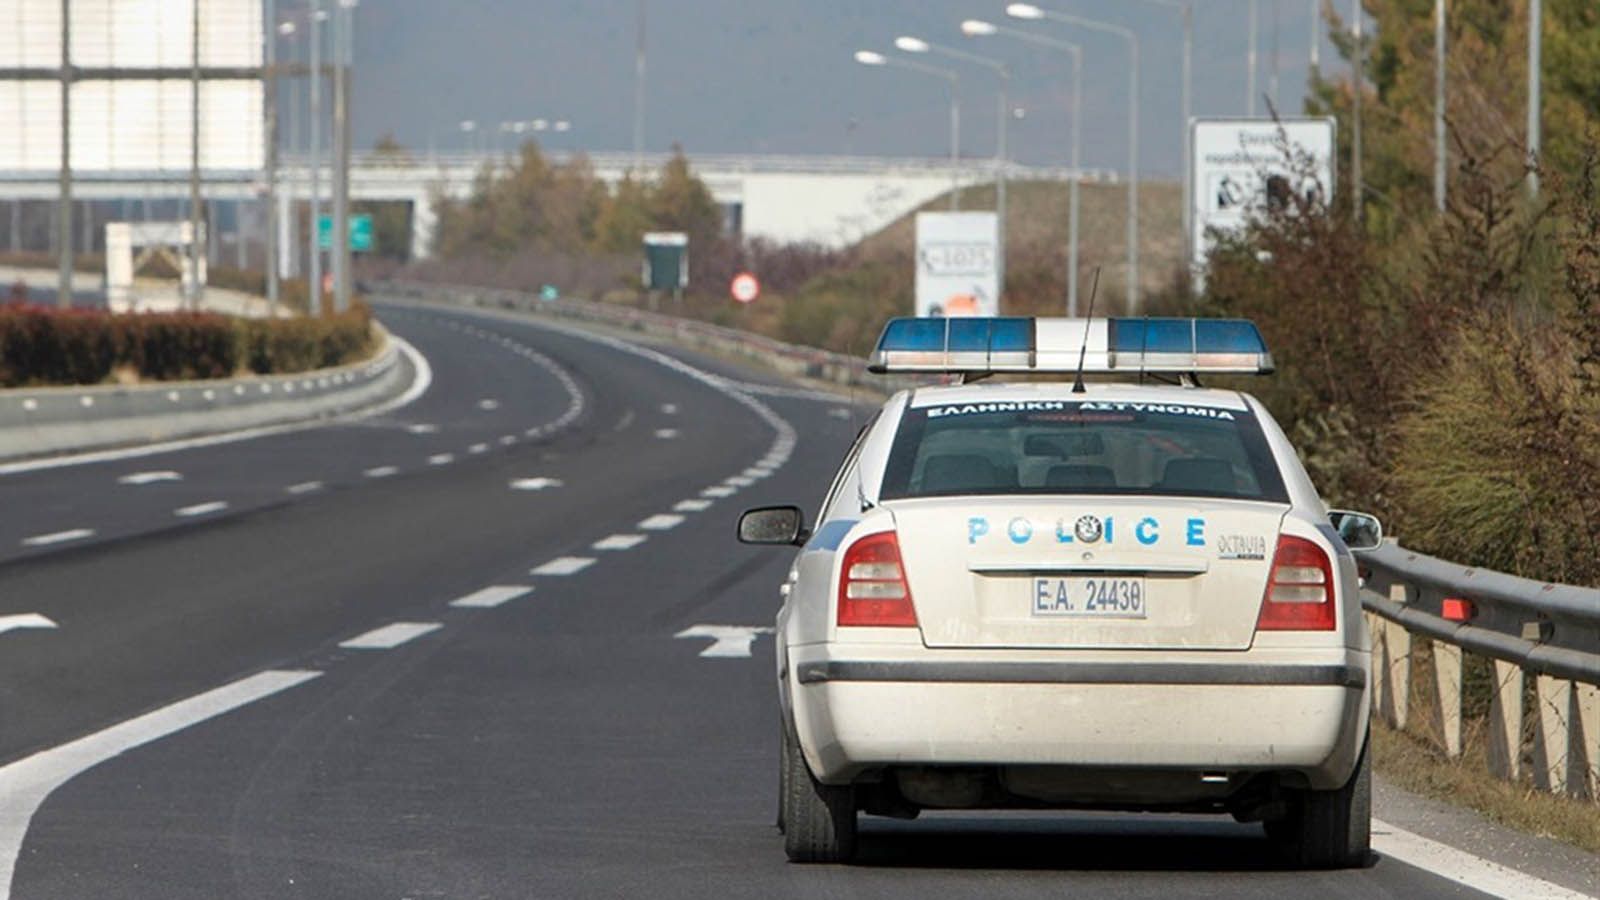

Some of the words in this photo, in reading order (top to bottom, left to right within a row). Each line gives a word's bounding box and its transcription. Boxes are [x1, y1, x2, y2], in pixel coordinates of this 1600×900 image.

[926, 401, 1064, 418] ΕΛΛΗΝΙΚΗ
[1079, 401, 1236, 420] ΑΣΤΥΝΟΜΙΑ
[968, 516, 1206, 546] POLICE
[1216, 534, 1266, 553] OCTAVIA
[1085, 580, 1141, 611] 24430
